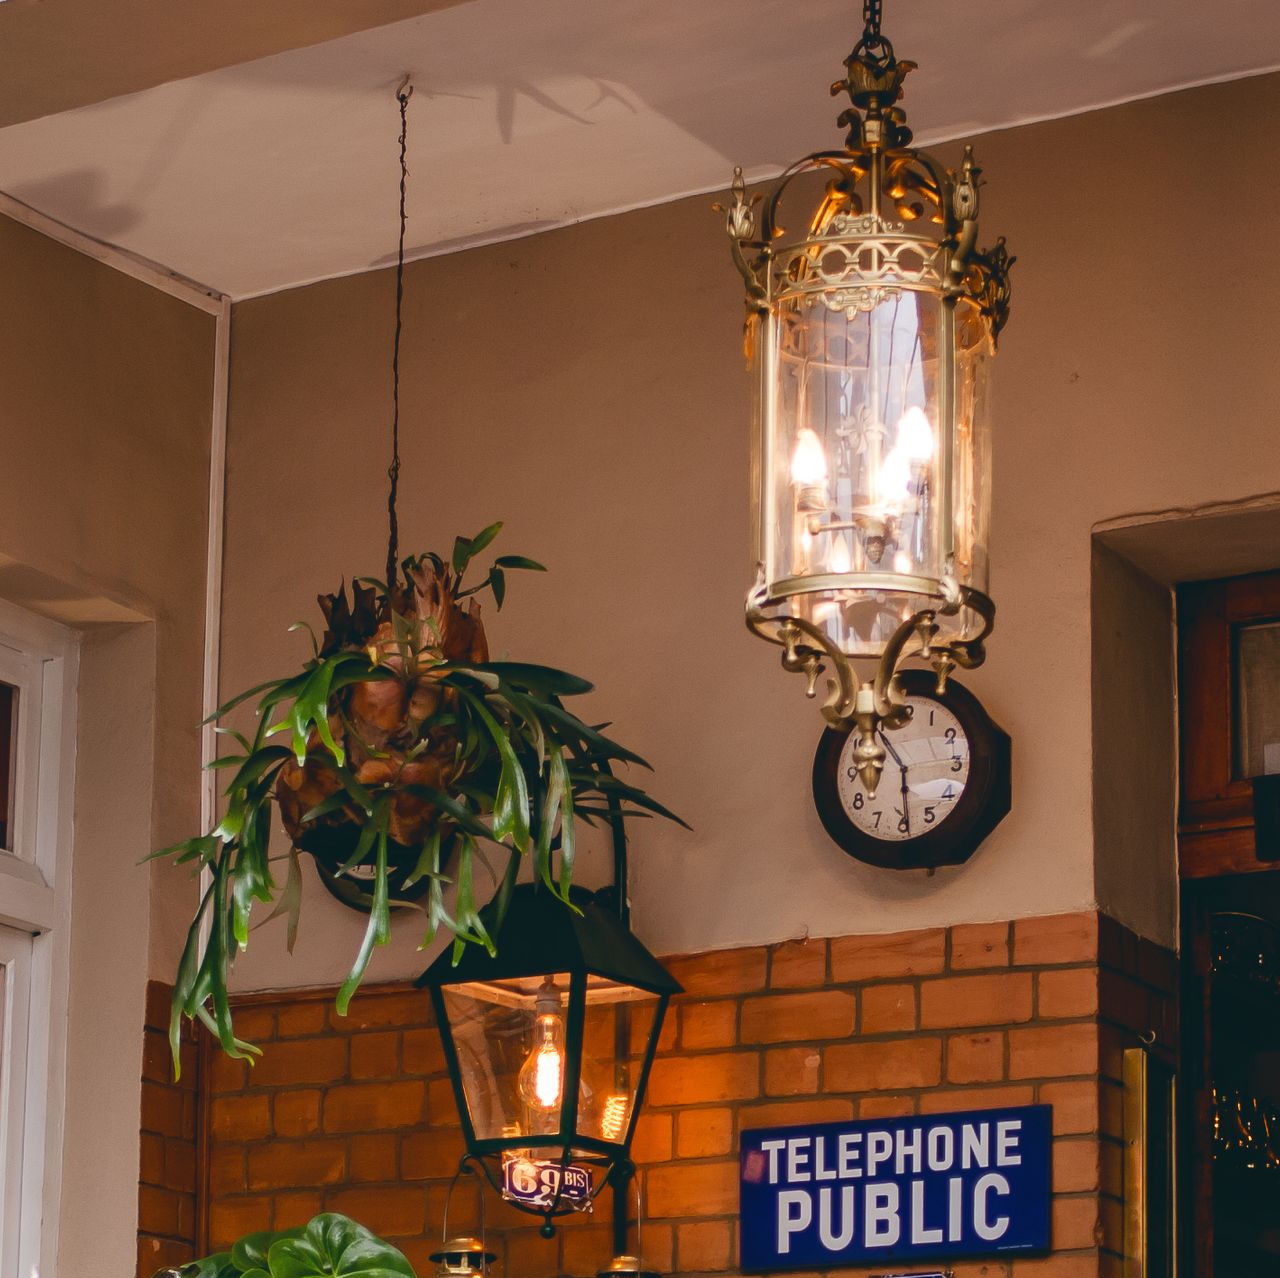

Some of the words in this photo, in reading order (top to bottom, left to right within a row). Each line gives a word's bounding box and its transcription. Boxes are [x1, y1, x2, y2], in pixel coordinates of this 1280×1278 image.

[944, 727, 957, 745] 2
[950, 755, 963, 772] 3
[846, 765, 858, 784] 9
[941, 783, 956, 800] 4
[852, 792, 865, 811] 8
[871, 811, 883, 829] 7
[924, 805, 936, 824] 5
[897, 816, 909, 834] 6
[761, 1119, 1022, 1185] TELEPHONE
[512, 1163, 561, 1197] 69
[564, 1171, 586, 1188] BIS
[776, 1172, 1011, 1254] PUBLIC
